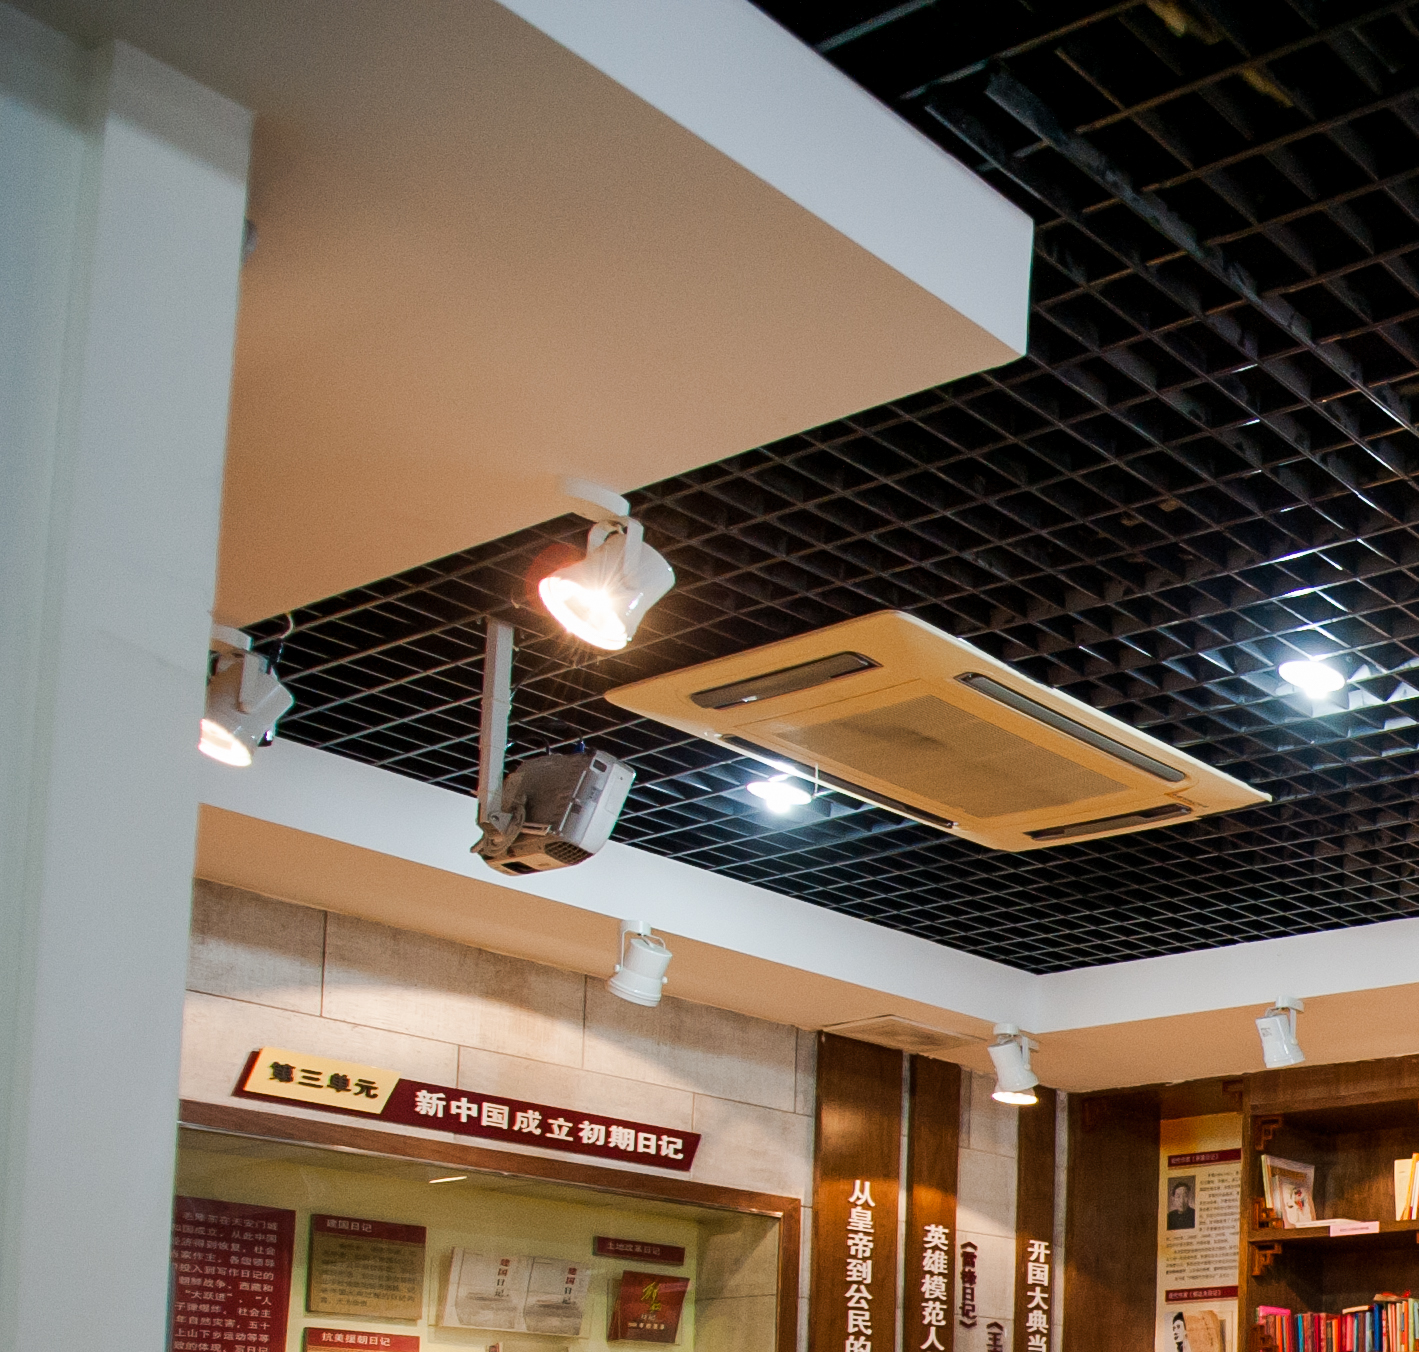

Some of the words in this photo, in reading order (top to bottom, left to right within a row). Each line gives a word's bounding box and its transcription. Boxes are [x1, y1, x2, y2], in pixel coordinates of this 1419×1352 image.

[269, 1060, 380, 1100] 第三单元
[414, 1088, 685, 1160] 新中国成立初期日记
[959, 1241, 978, 1329] 《雷锋日记》
[321, 1331, 392, 1347] 抗美援朝日记
